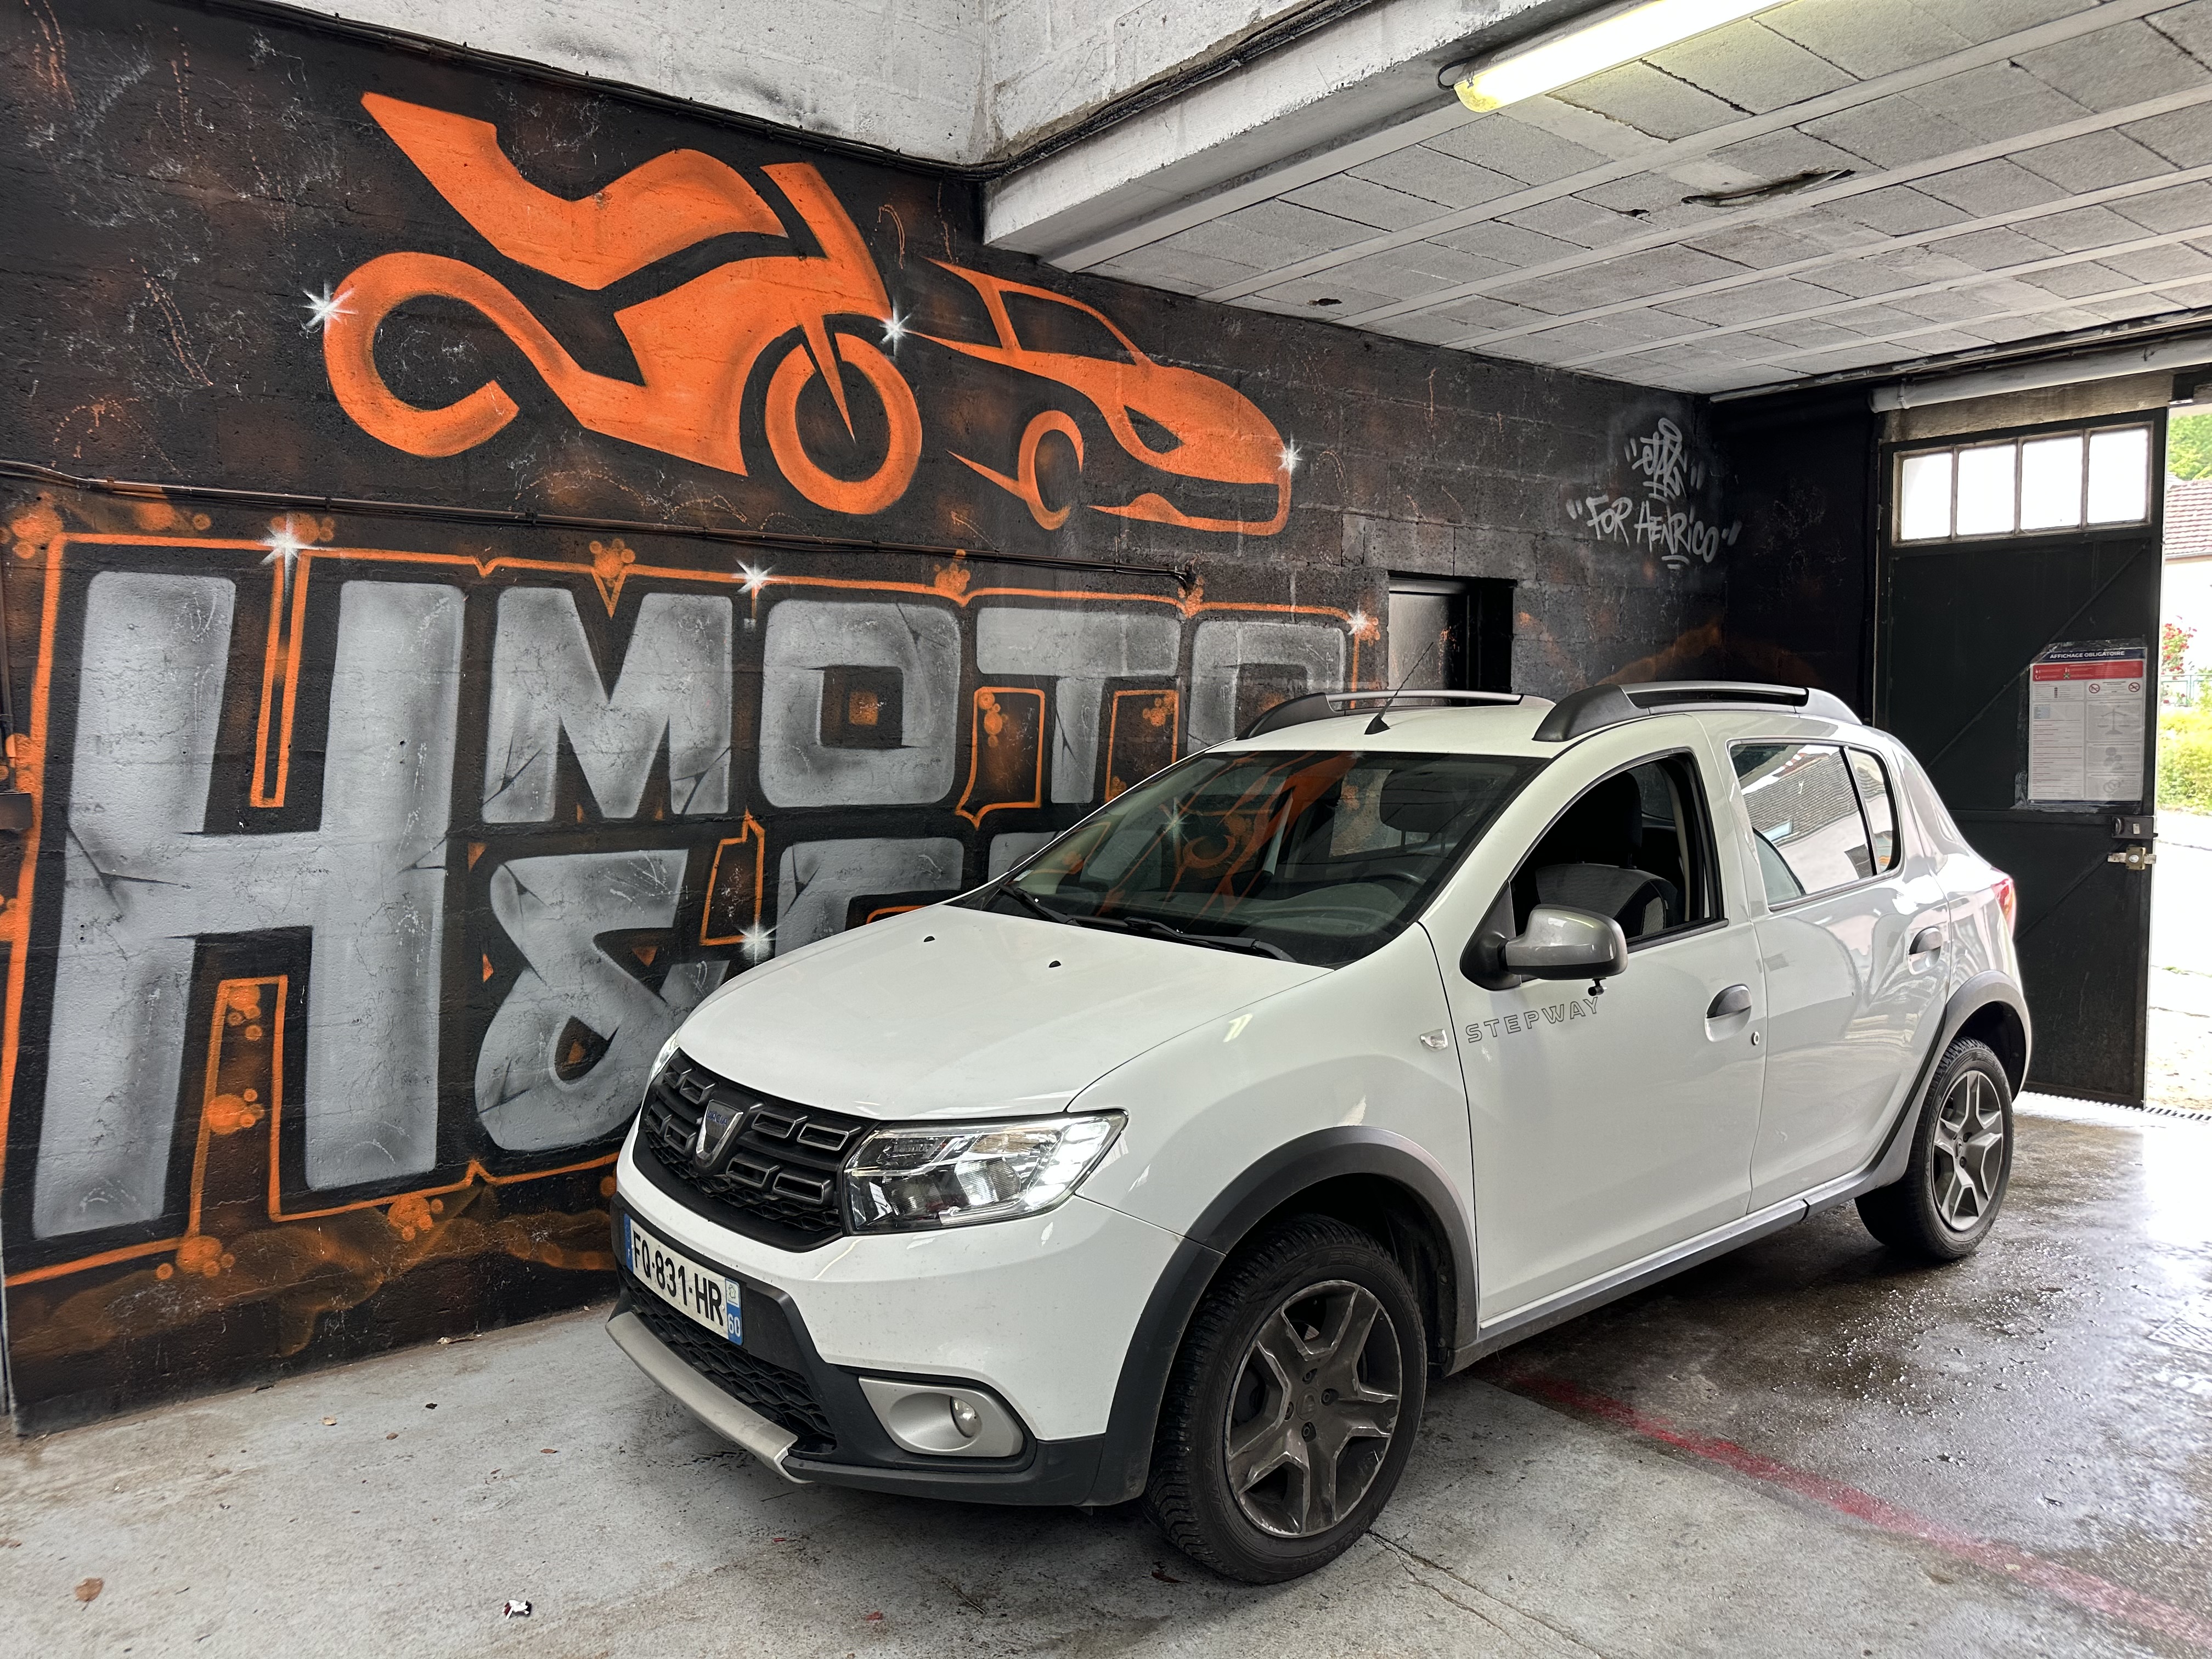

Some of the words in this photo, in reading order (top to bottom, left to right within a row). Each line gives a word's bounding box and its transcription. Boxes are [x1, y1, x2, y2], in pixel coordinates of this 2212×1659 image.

[33, 571, 465, 1239] H
[1465, 996, 1599, 1043] STEPWAY
[633, 1230, 724, 1326] FQ-831-HR
[727, 1313, 741, 1337] 60
